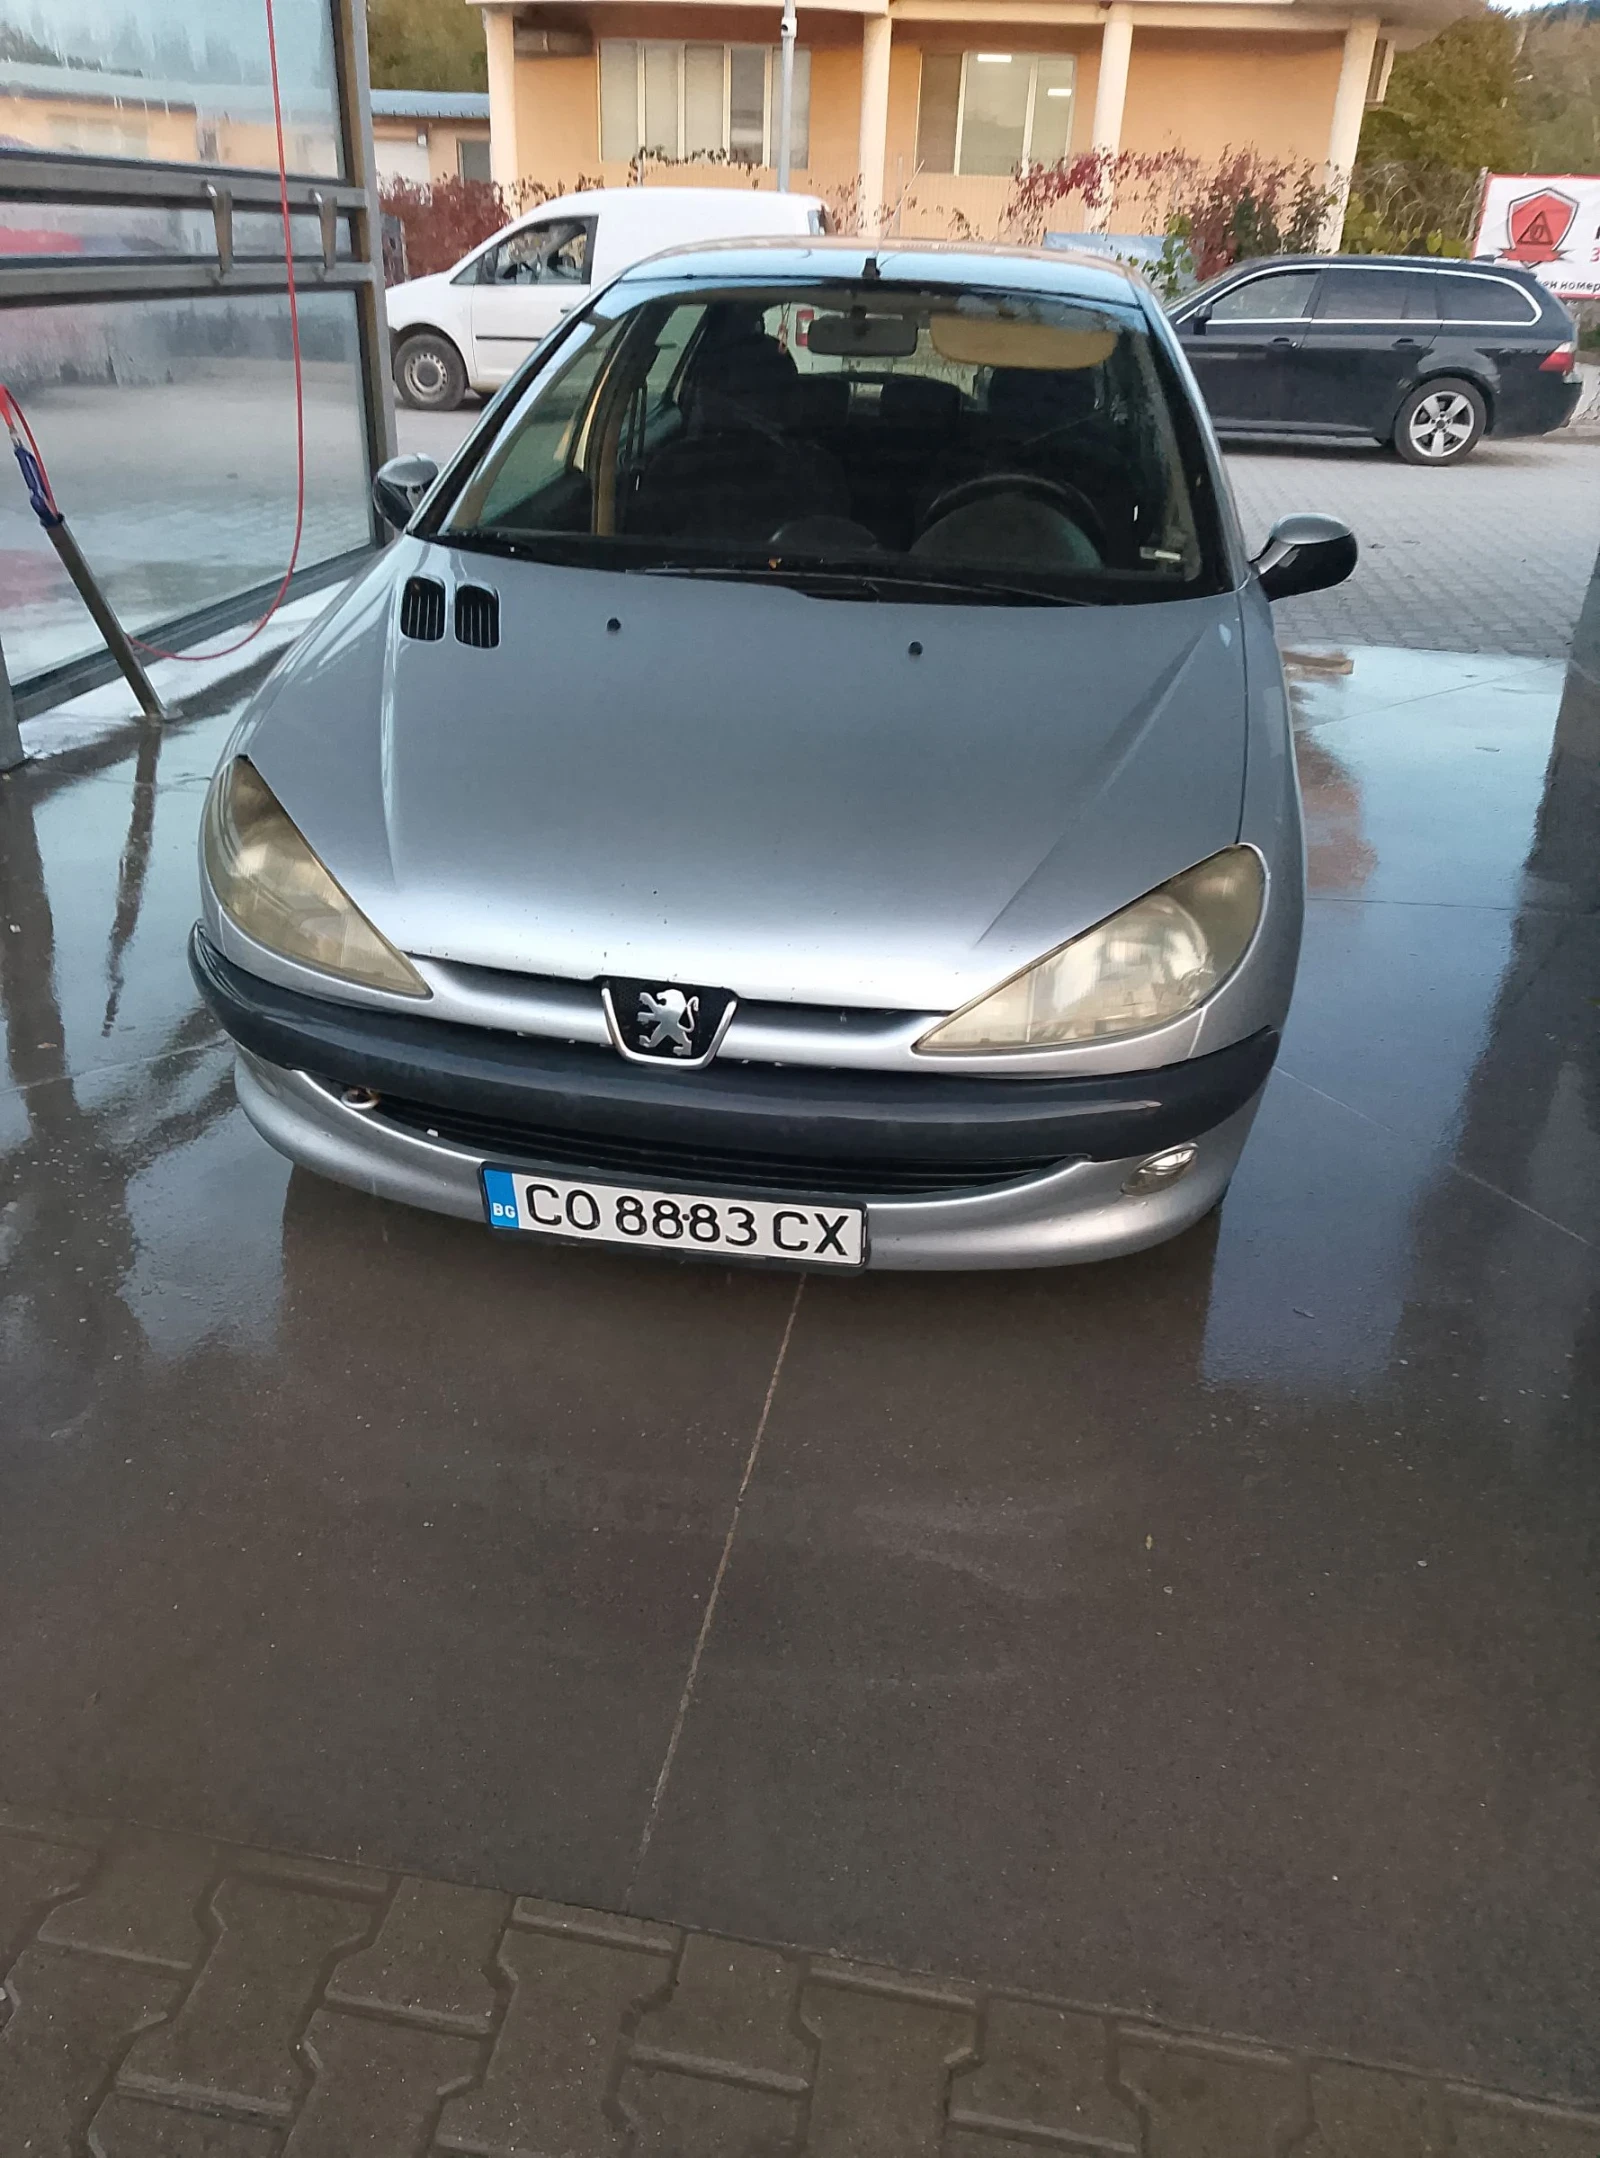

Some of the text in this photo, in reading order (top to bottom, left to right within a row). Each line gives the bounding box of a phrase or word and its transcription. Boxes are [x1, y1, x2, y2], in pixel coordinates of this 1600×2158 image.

[493, 1202, 516, 1218] BG
[615, 1195, 758, 1247] 8883
[772, 1210, 849, 1256] CX
